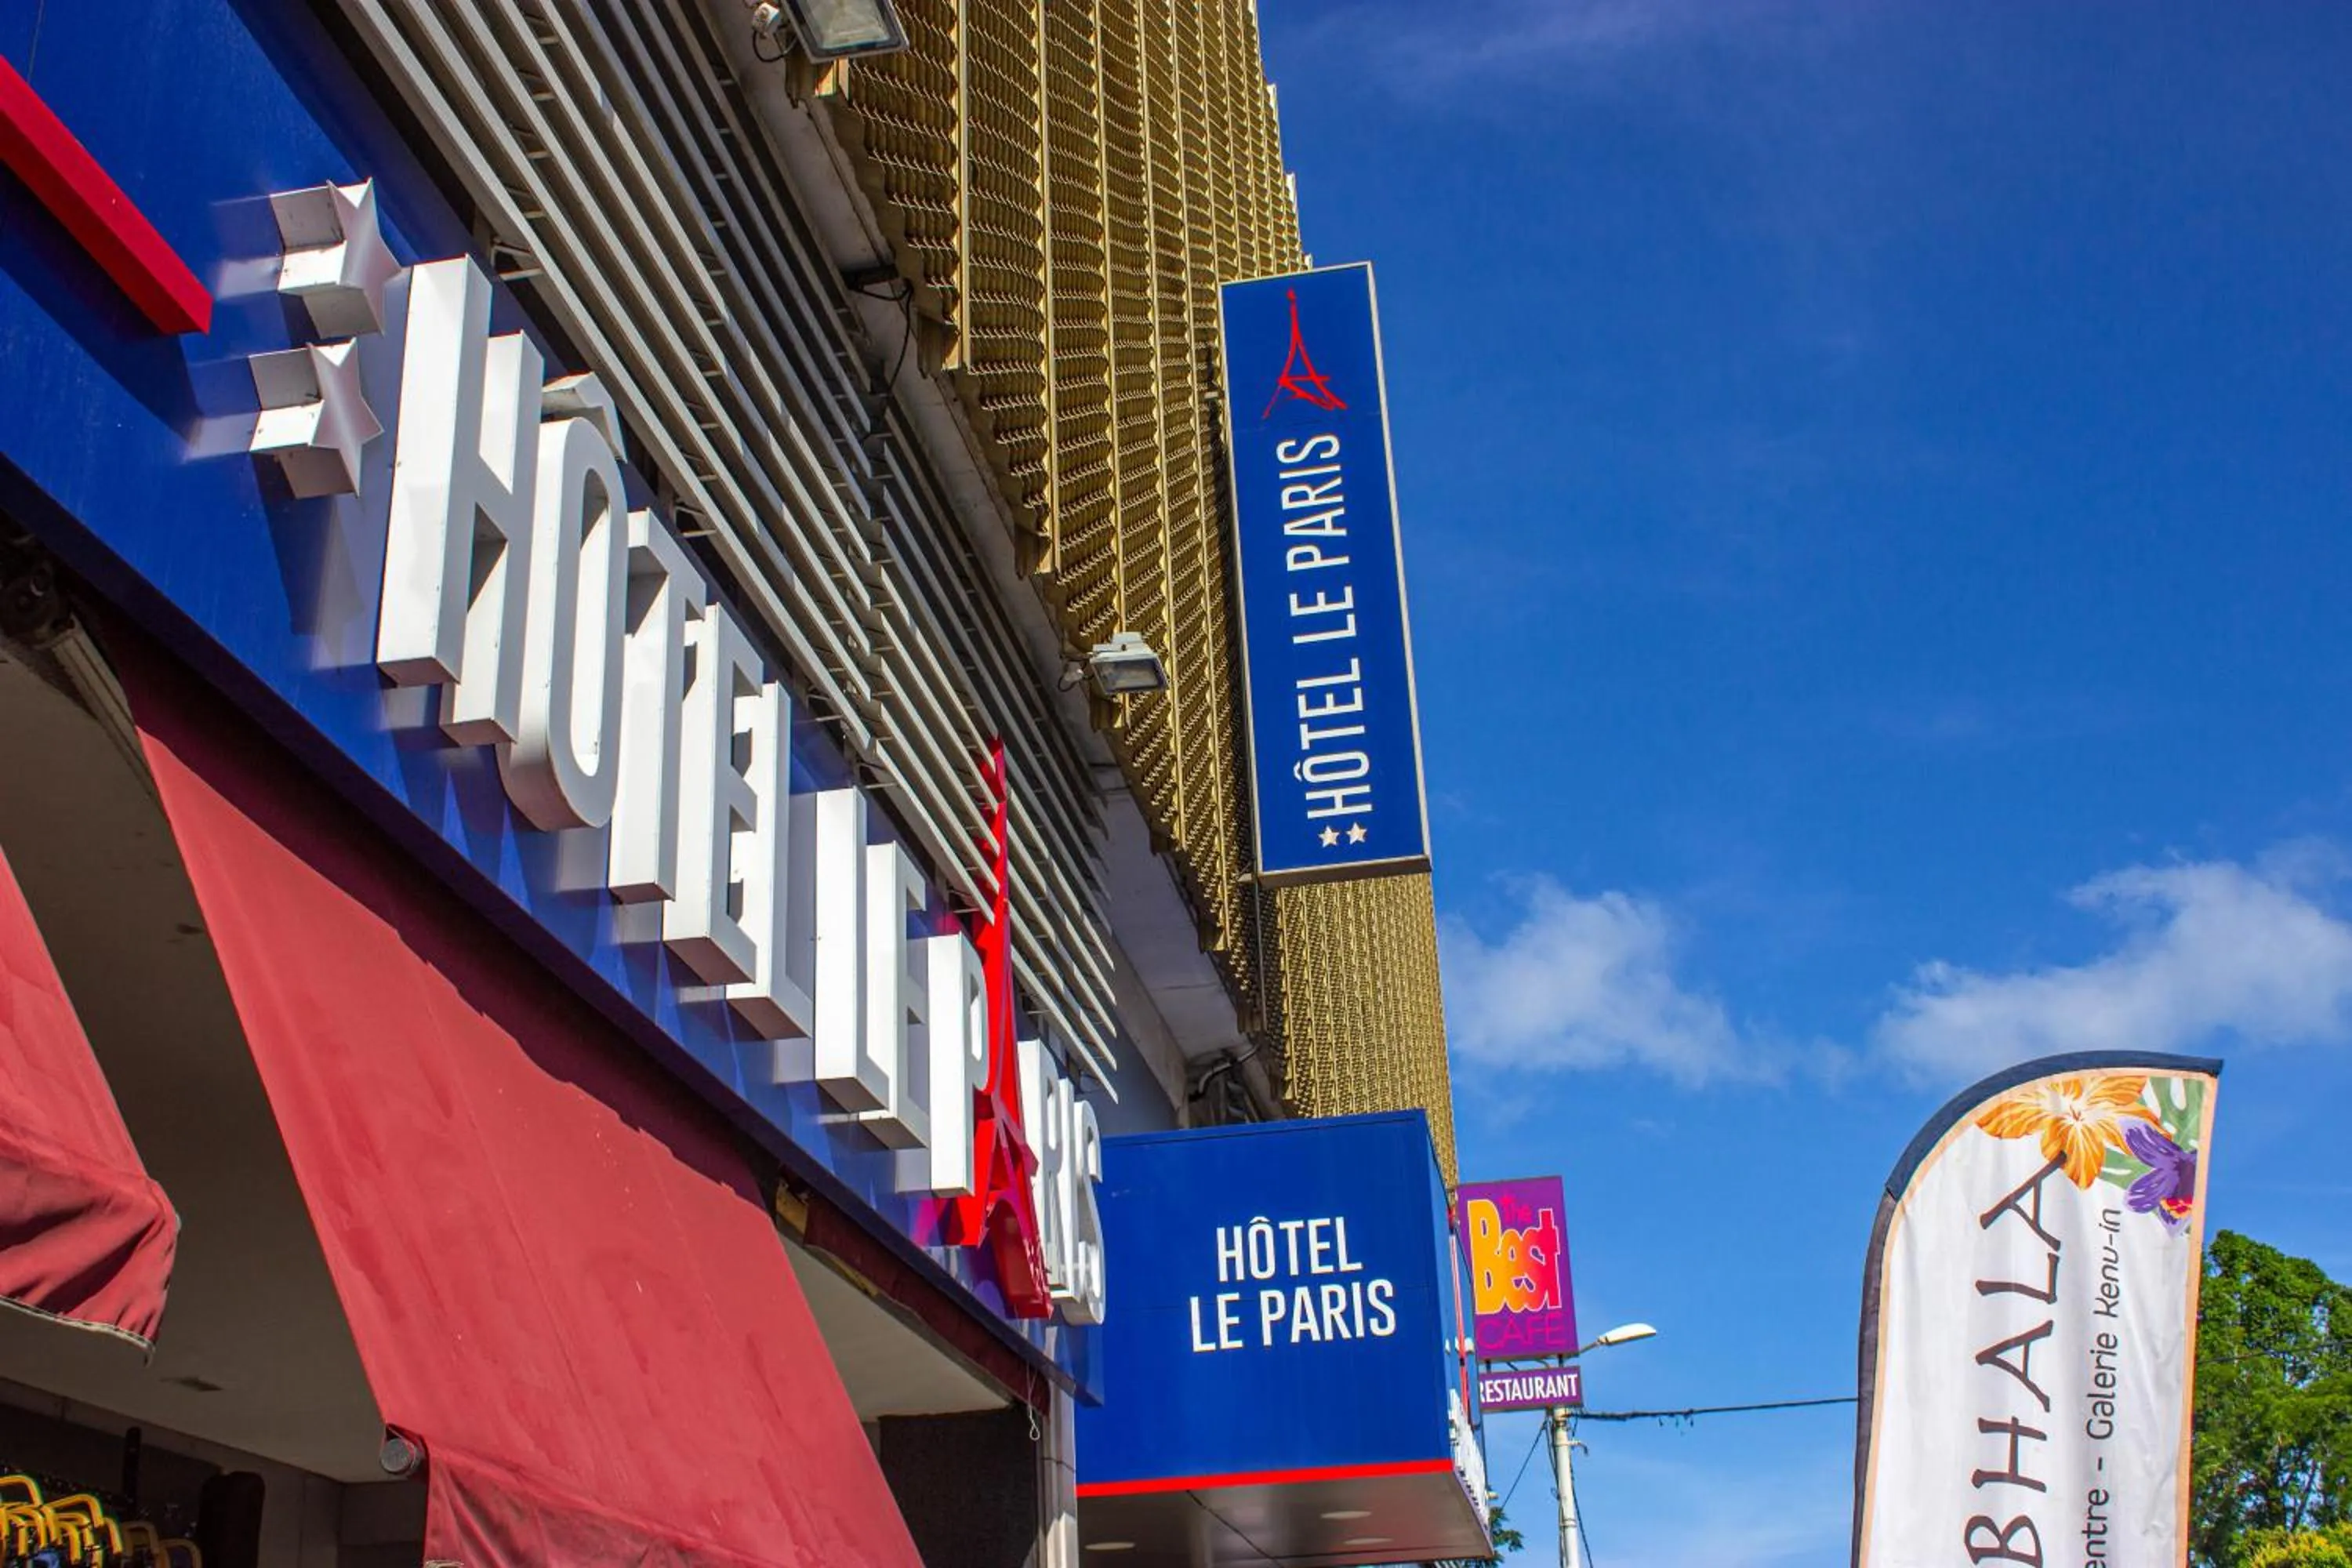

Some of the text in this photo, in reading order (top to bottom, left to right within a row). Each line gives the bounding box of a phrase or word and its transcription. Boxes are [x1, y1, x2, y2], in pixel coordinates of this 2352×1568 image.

[1276, 434, 1372, 820] HÔTEL LE PARIS
[376, 253, 812, 1040] HÔTEL
[815, 786, 930, 1149] LE
[1217, 1216, 1363, 1283] HÔTEL
[1468, 1199, 1562, 1316] Best
[1500, 1194, 1534, 1225] The
[2094, 1208, 2121, 1318] Kenu-in
[1190, 1279, 1396, 1353] LE PARIS
[1964, 1151, 2067, 1568] BHALA
[2085, 1333, 2118, 1441] Galerie
